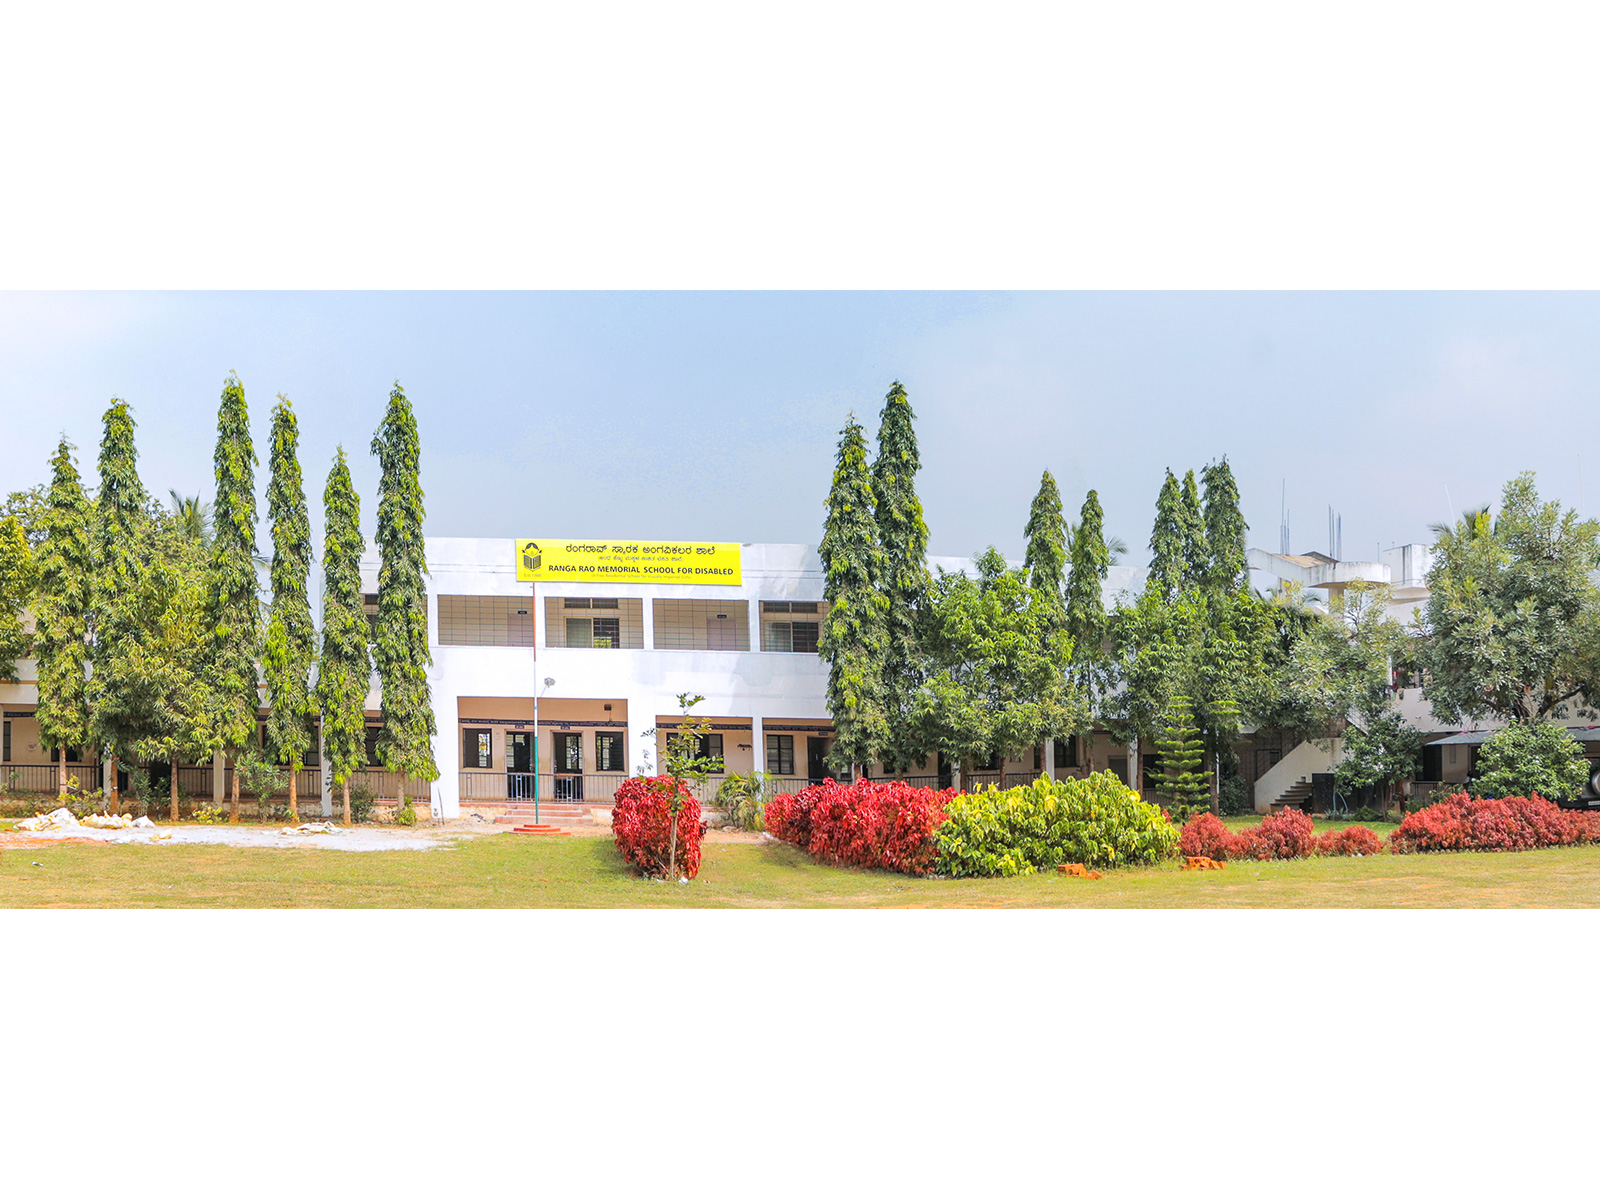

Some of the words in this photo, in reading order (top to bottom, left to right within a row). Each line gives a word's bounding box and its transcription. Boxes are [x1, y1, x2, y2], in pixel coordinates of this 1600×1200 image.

[565, 543, 607, 553] ರಂಗರಾವ್
[611, 544, 639, 555] ಸ್ಮಾರಕ
[642, 545, 692, 555] ಅಂಗವಿಕಲರ
[695, 545, 716, 555] ಶಾಲೆ
[578, 565, 595, 573] RAO
[643, 566, 675, 574] SCHOOL
[695, 567, 734, 575] DISABLED
